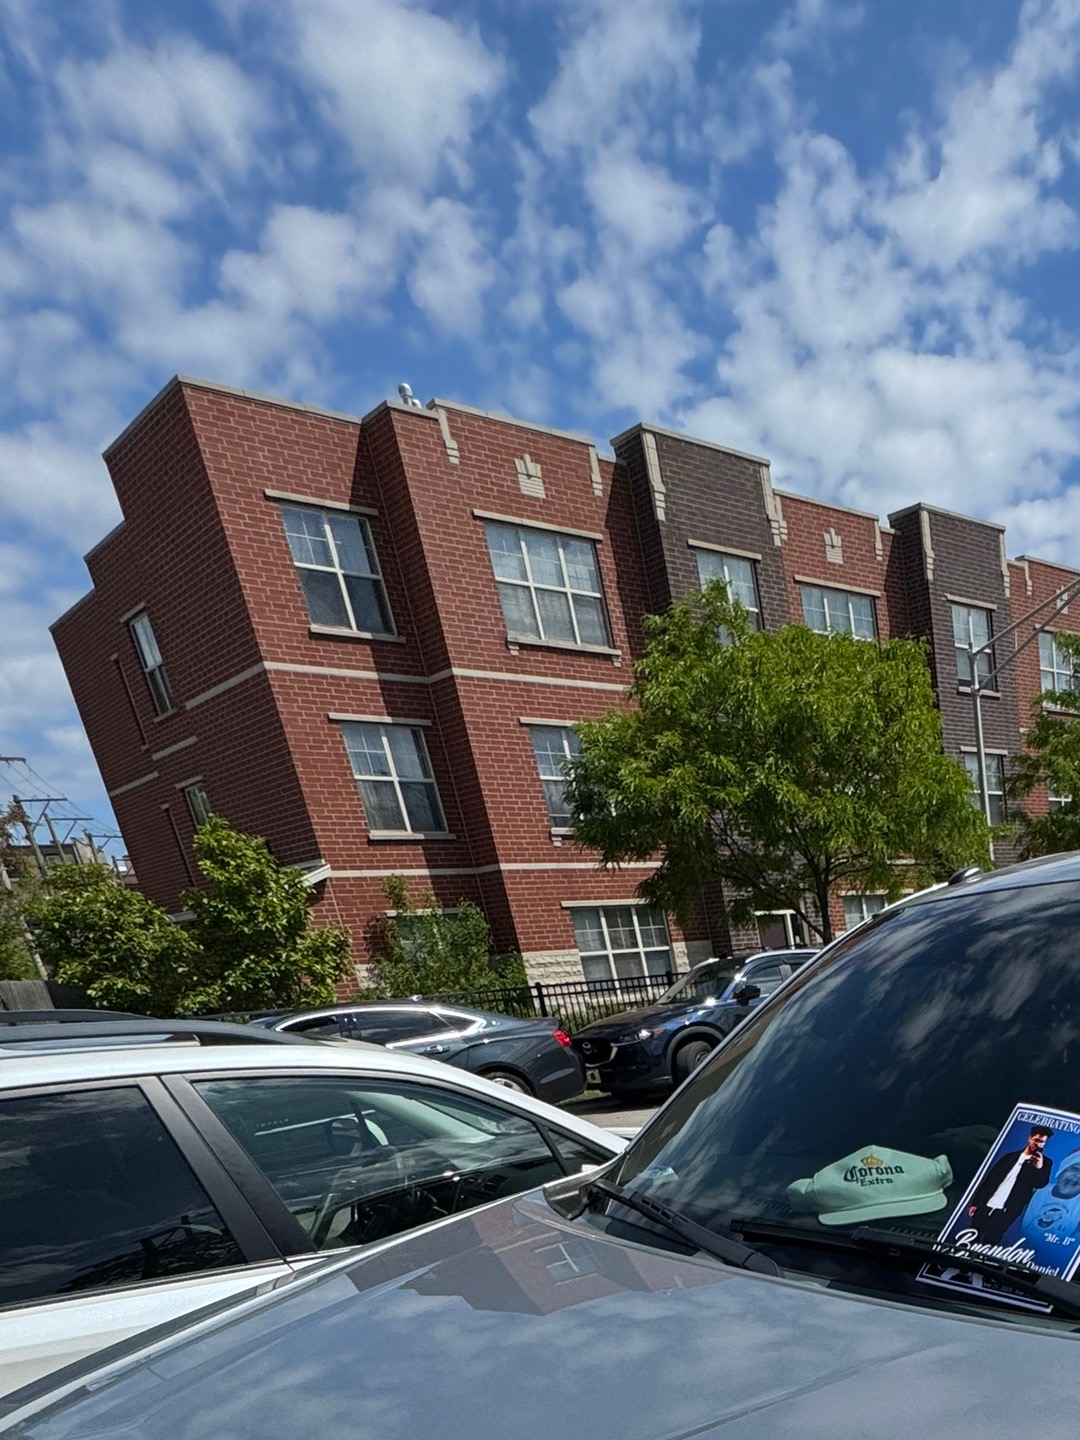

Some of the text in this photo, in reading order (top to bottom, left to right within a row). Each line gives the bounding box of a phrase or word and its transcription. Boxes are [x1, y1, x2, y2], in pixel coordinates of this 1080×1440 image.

[843, 1165, 905, 1184] Corona
[859, 1177, 894, 1187] Extra
[955, 1228, 1036, 1264] Brandon
[1026, 1261, 1060, 1277] Daniel
